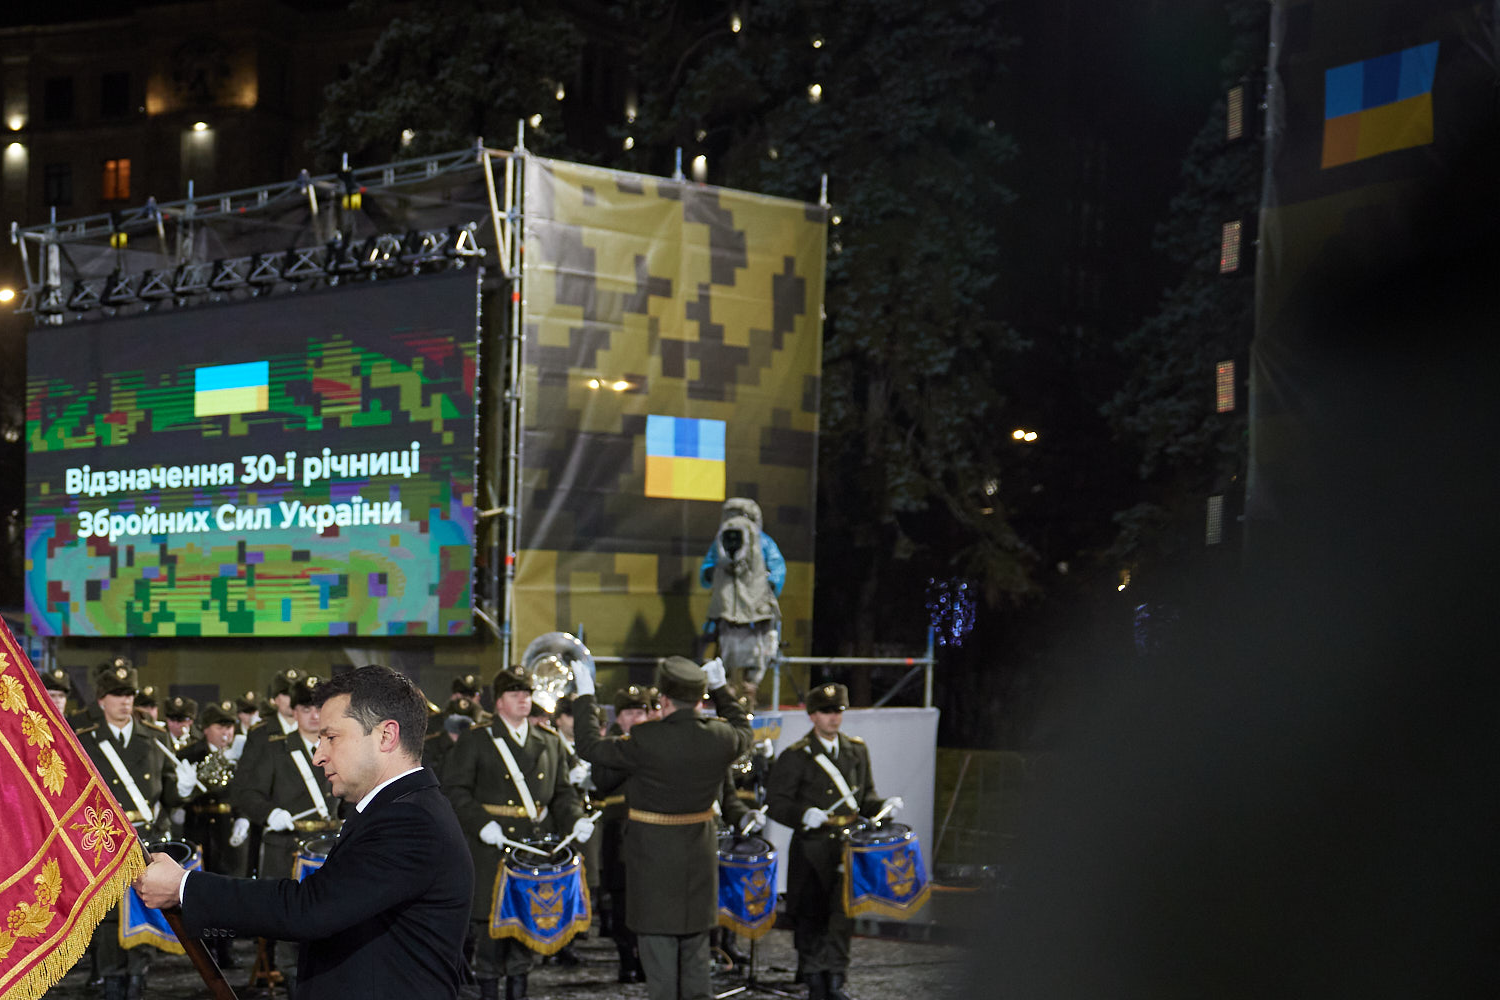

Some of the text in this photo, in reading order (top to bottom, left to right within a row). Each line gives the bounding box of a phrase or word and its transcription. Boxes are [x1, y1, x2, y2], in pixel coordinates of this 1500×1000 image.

[65, 440, 421, 498] Відзначення 30-ї річниці
[76, 495, 403, 543] Збройних Сил України
